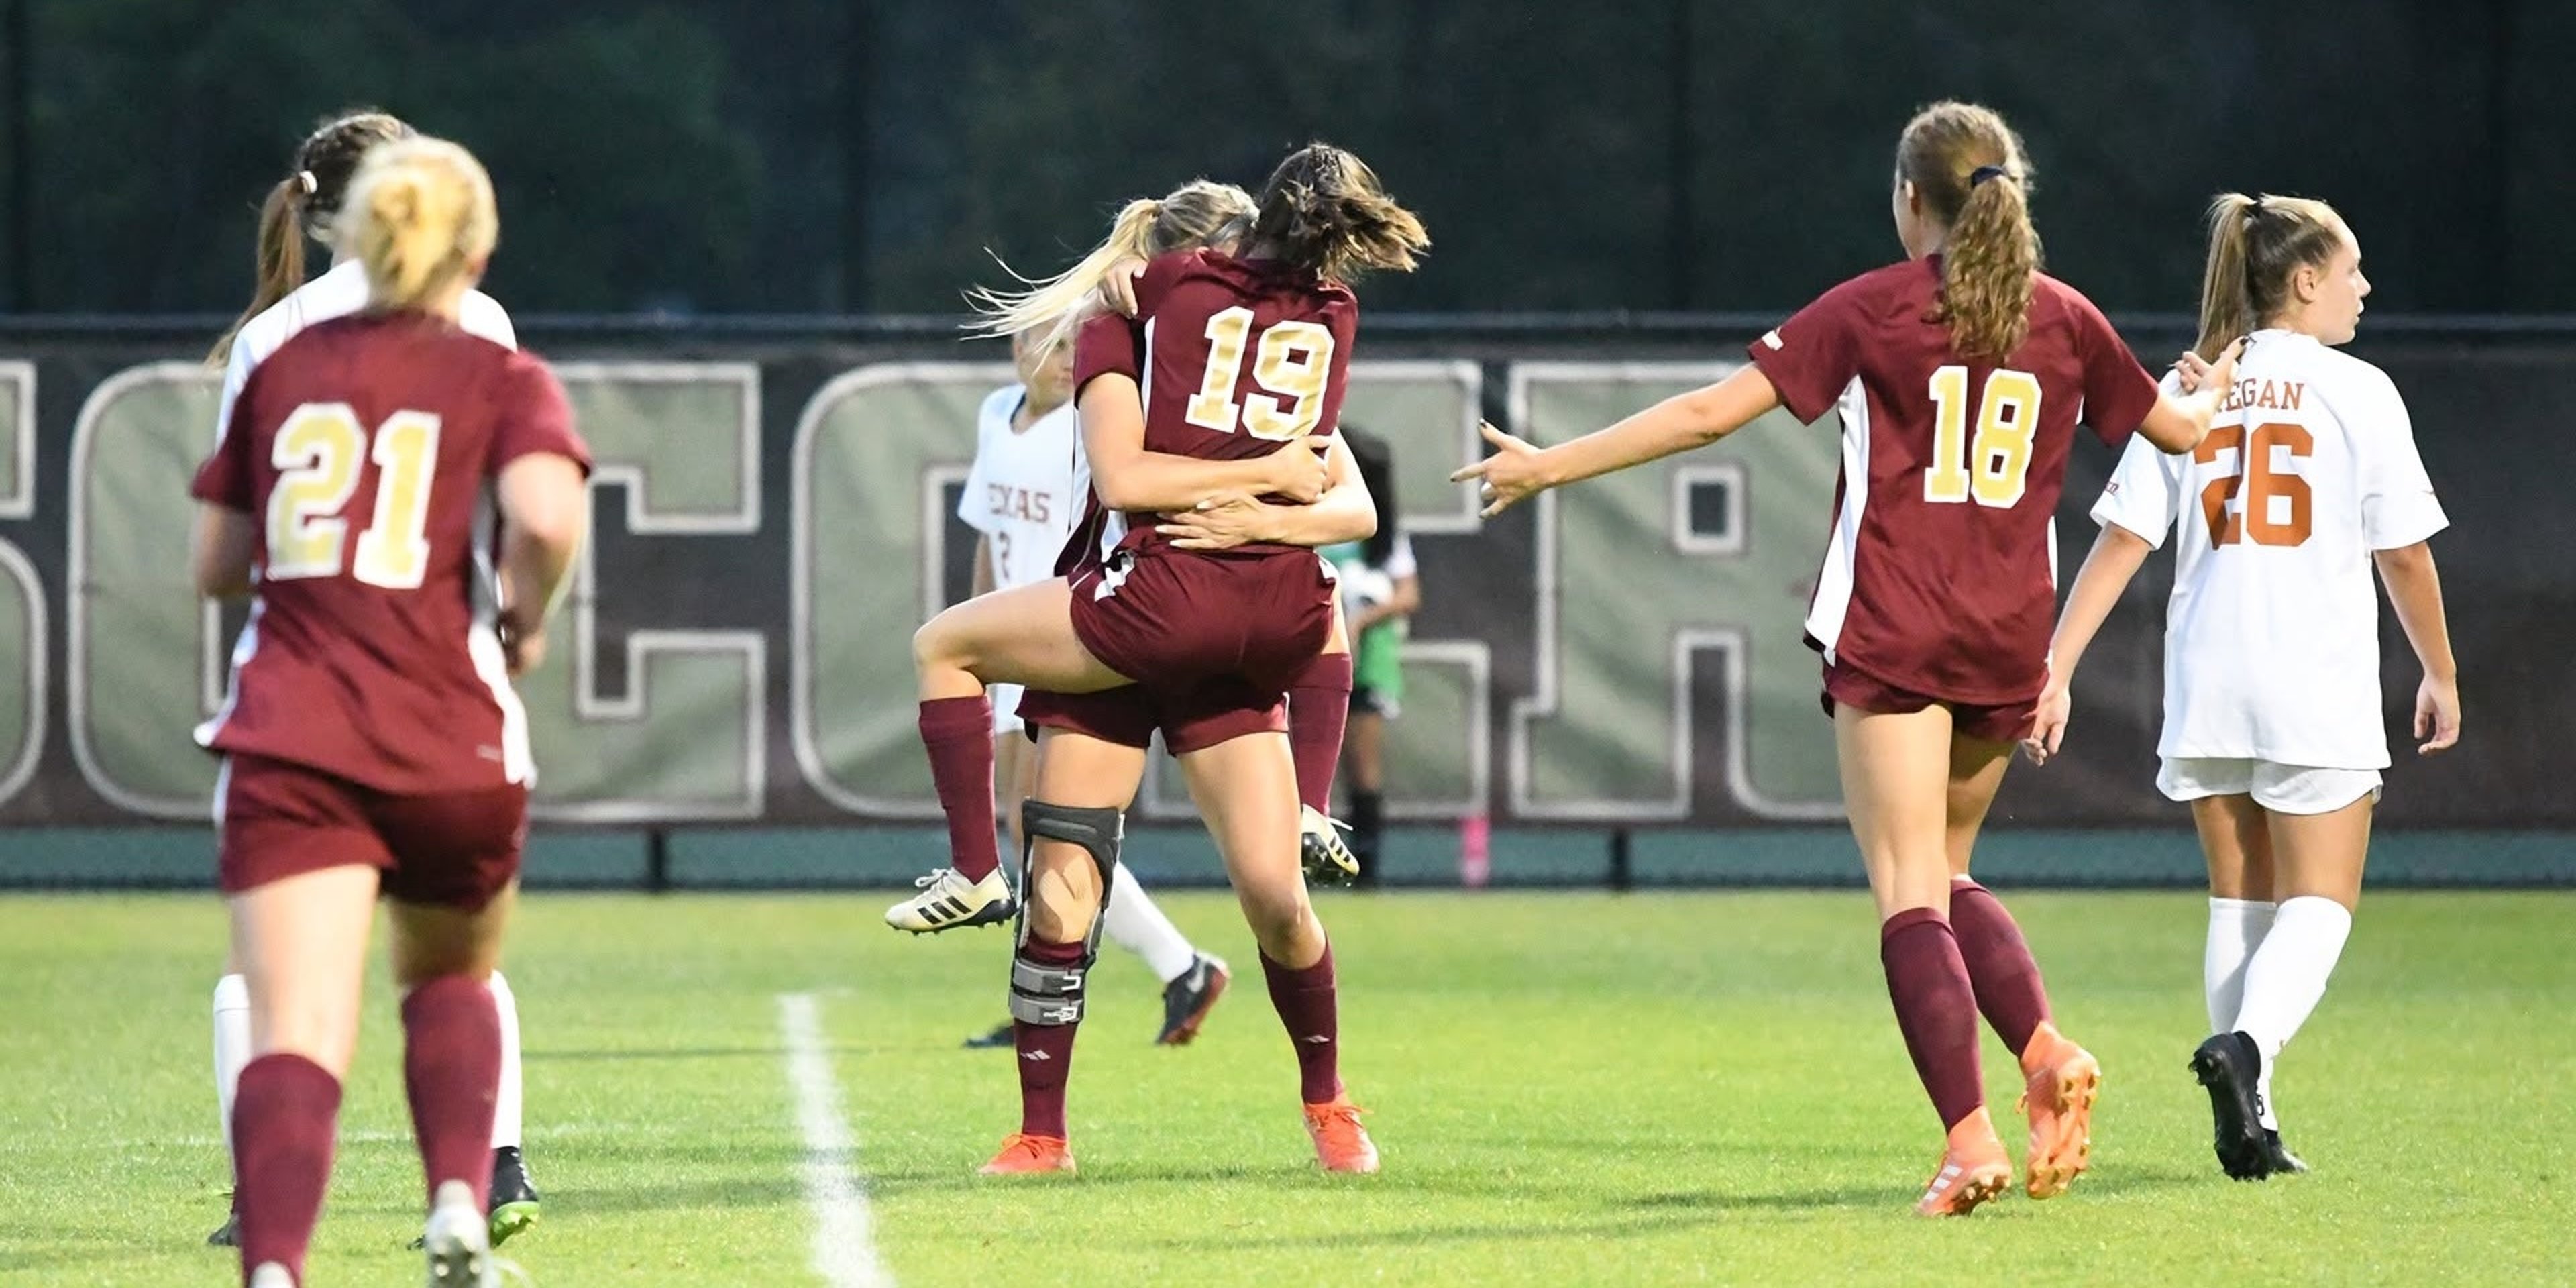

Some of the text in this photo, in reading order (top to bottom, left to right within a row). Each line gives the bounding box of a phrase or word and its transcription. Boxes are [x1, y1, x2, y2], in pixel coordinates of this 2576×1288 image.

[1185, 306, 1335, 442] 19
[1924, 366, 2043, 509] 18
[2216, 378, 2305, 413] EGAN
[265, 402, 442, 589] 21
[2194, 422, 2314, 551] 26
